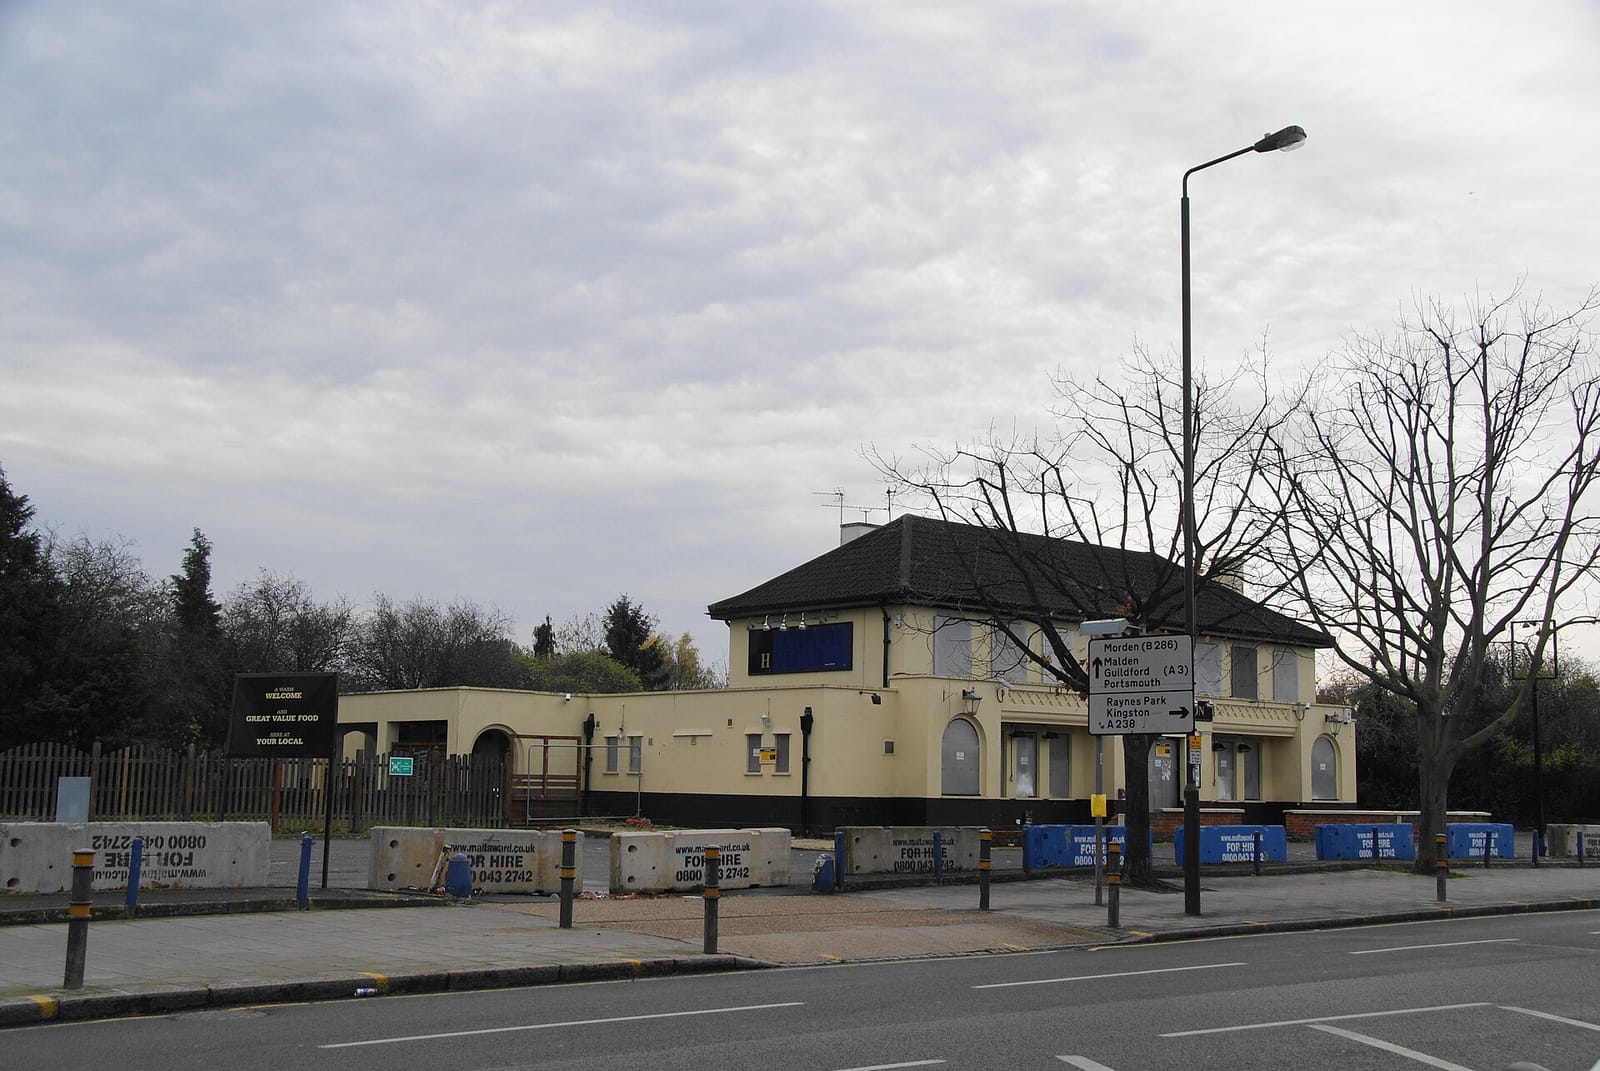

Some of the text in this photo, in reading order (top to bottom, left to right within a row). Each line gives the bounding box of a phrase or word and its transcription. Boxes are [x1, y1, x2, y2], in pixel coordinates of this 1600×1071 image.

[1104, 643, 1139, 653] Morden
[1104, 657, 1139, 667] Malden
[1104, 667, 1150, 678] Guildford
[1104, 678, 1161, 689] Portsmouth
[265, 692, 302, 700] WELCOME
[1106, 696, 1167, 708] Raynes Park
[297, 714, 319, 722] FOOD
[1106, 708, 1150, 719] Kingston
[278, 737, 304, 745] LOCAL
[92, 835, 206, 849] 0800 04 2742
[1226, 841, 1255, 852] FOR HIR
[901, 847, 948, 860] FOR HIE
[490, 855, 524, 868] HIRE
[1074, 855, 1093, 866] 0800
[480, 870, 503, 883] 043
[505, 870, 533, 883] 2742
[676, 869, 703, 882] 0800
[726, 866, 750, 880] 2742
